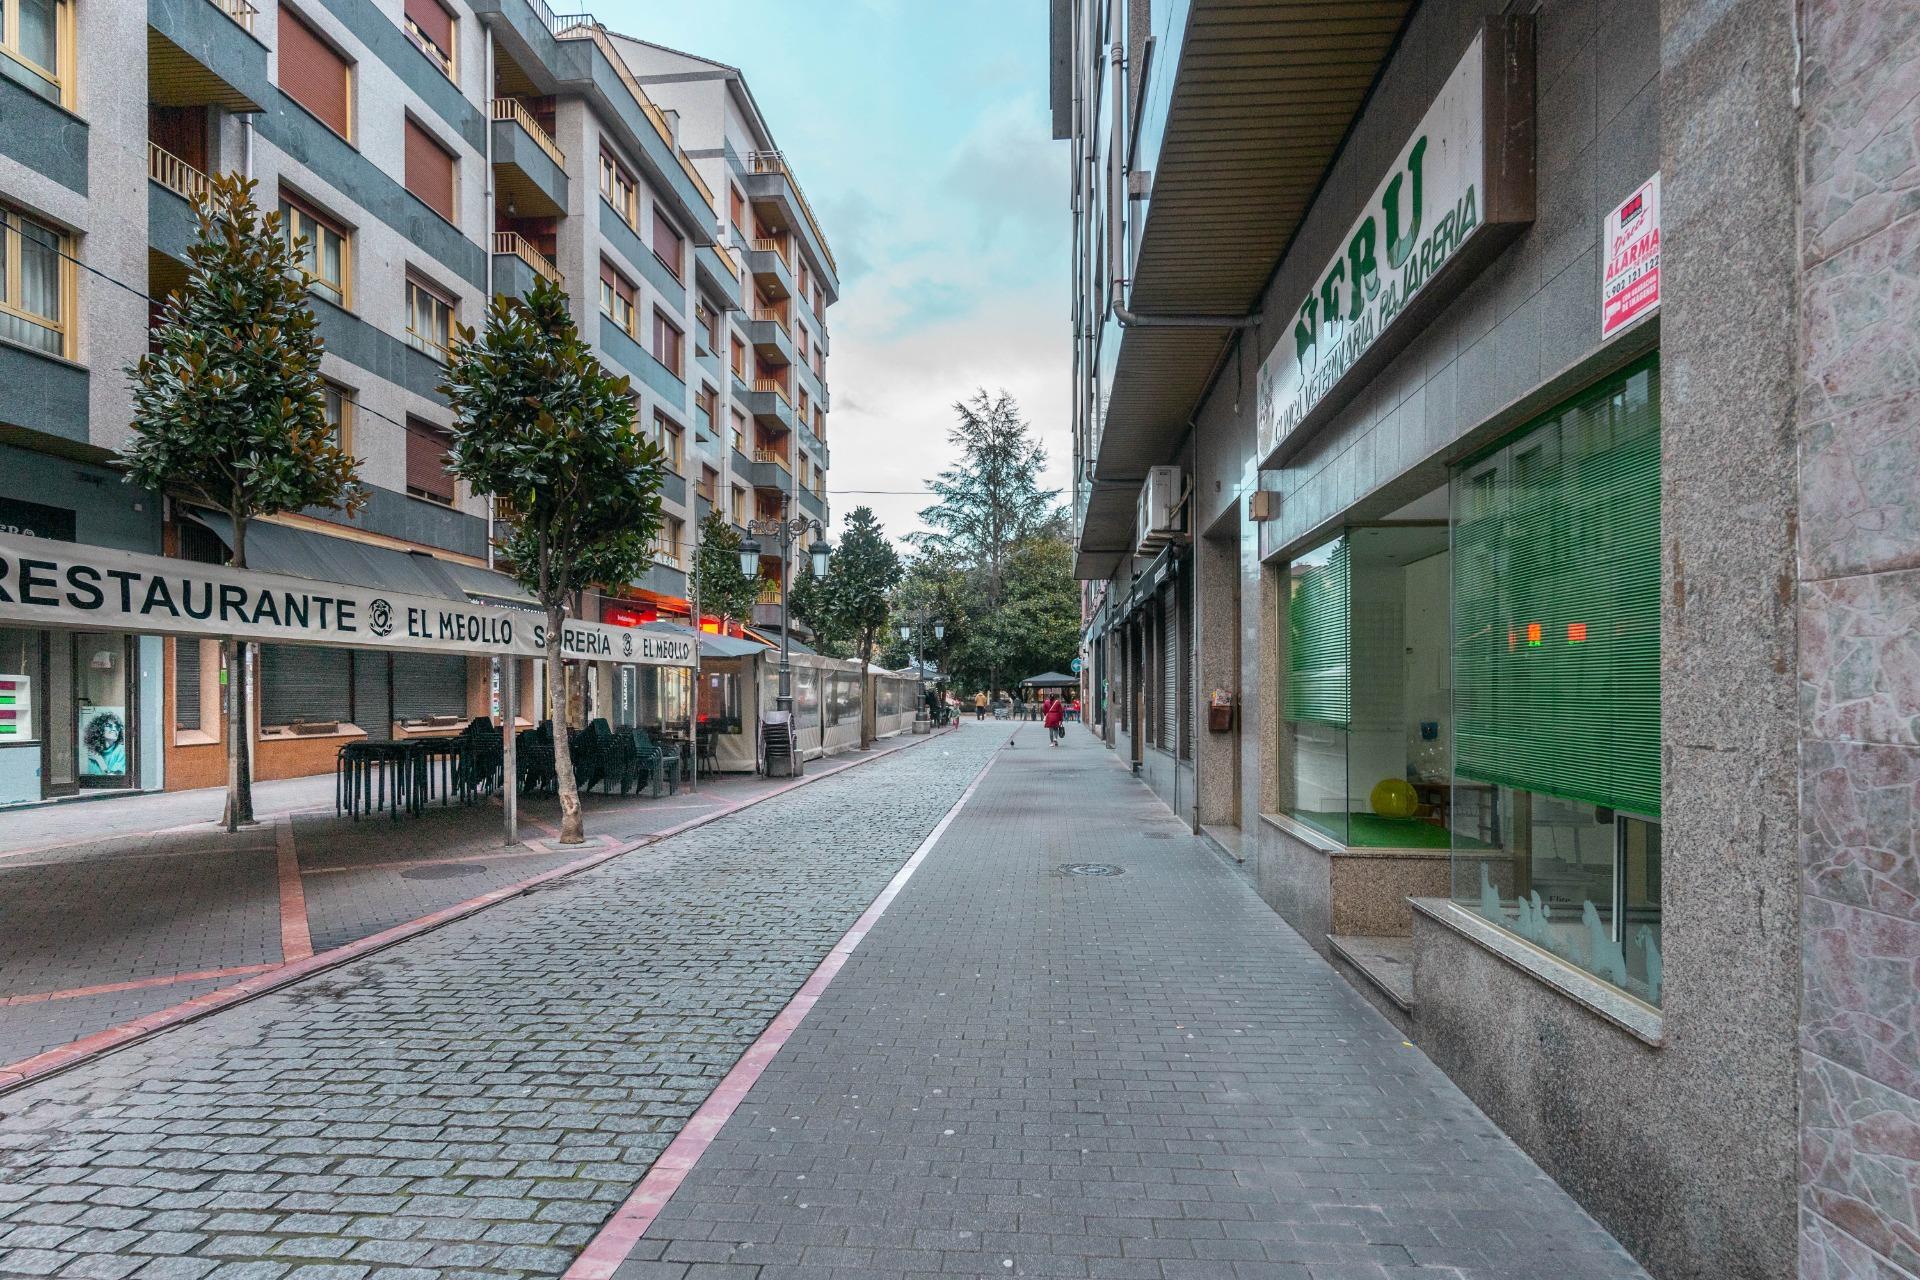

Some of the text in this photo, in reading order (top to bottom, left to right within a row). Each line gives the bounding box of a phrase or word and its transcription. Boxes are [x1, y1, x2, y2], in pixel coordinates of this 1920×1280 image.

[1605, 227, 1660, 282] ALARMA
[1612, 278, 1626, 296] 902
[1628, 266, 1642, 285] 121
[1645, 254, 1660, 273] 122
[1304, 308, 1373, 412] VETERINARIA
[1379, 183, 1477, 331] PAJARERIA
[408, 608, 433, 639] EL
[439, 612, 513, 645] MEOLLO
[533, 624, 690, 660] SRERÍA EL MEOLLO
